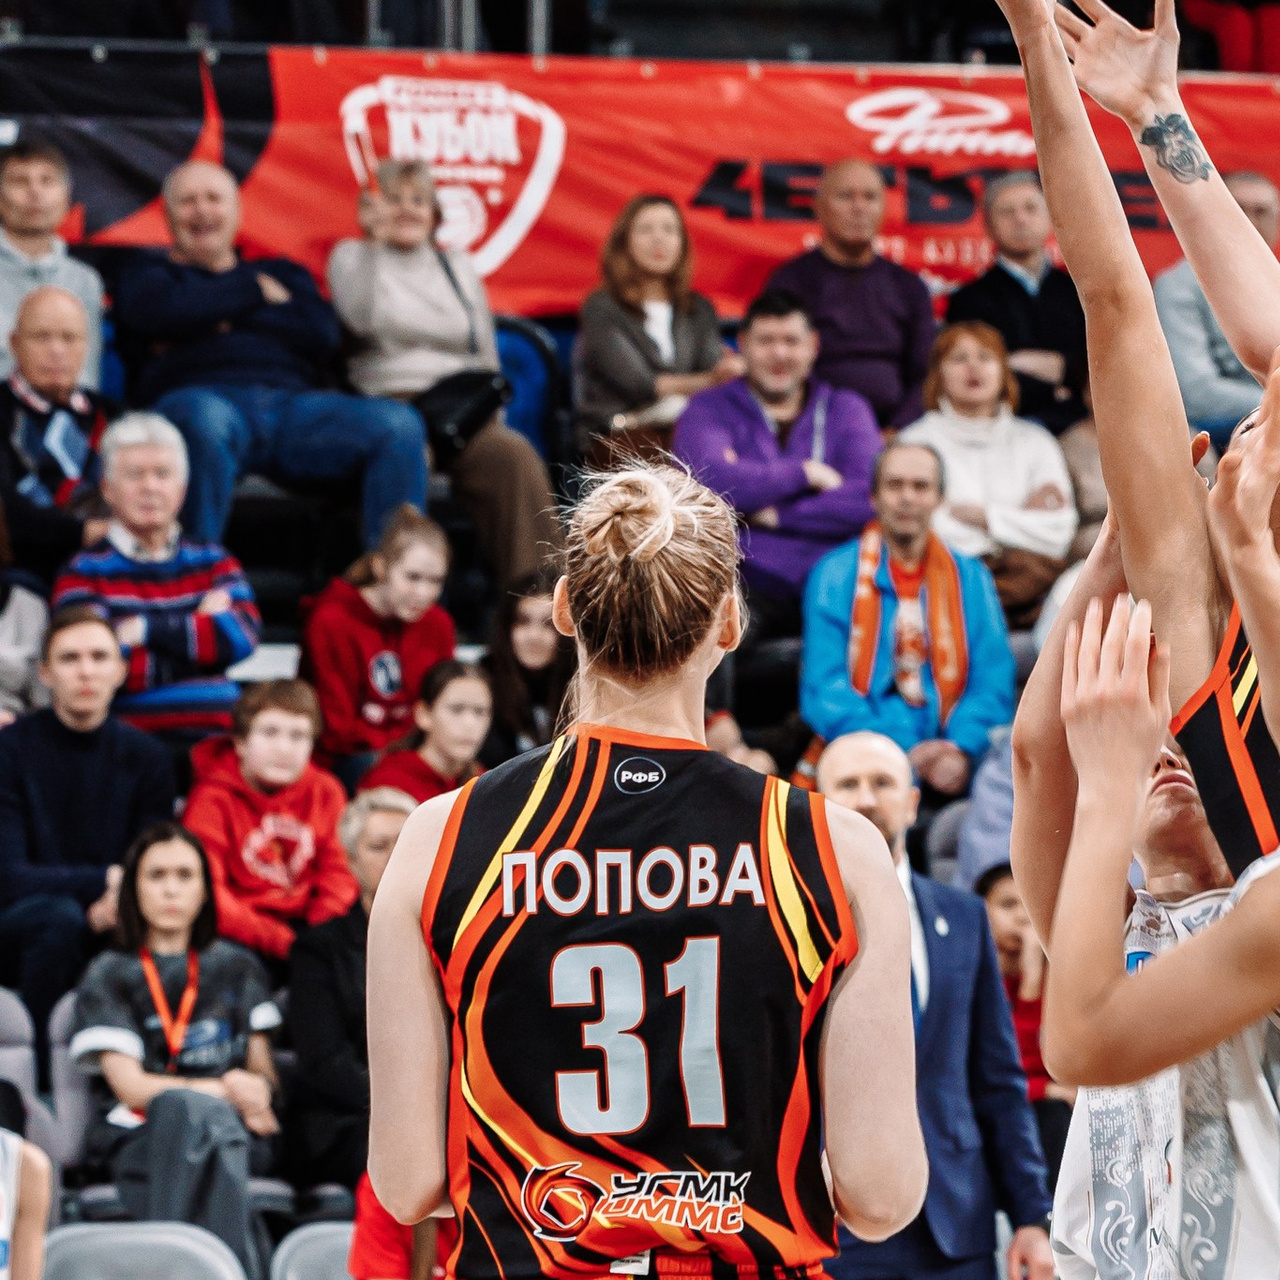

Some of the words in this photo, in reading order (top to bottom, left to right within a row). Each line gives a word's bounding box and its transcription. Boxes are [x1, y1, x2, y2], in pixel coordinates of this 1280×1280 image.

[620, 770, 660, 784] РФБ
[501, 842, 767, 917] ПОПОВА
[550, 934, 727, 1136] 31
[610, 1171, 752, 1206] УГМК
[600, 1193, 746, 1234] UMMC
